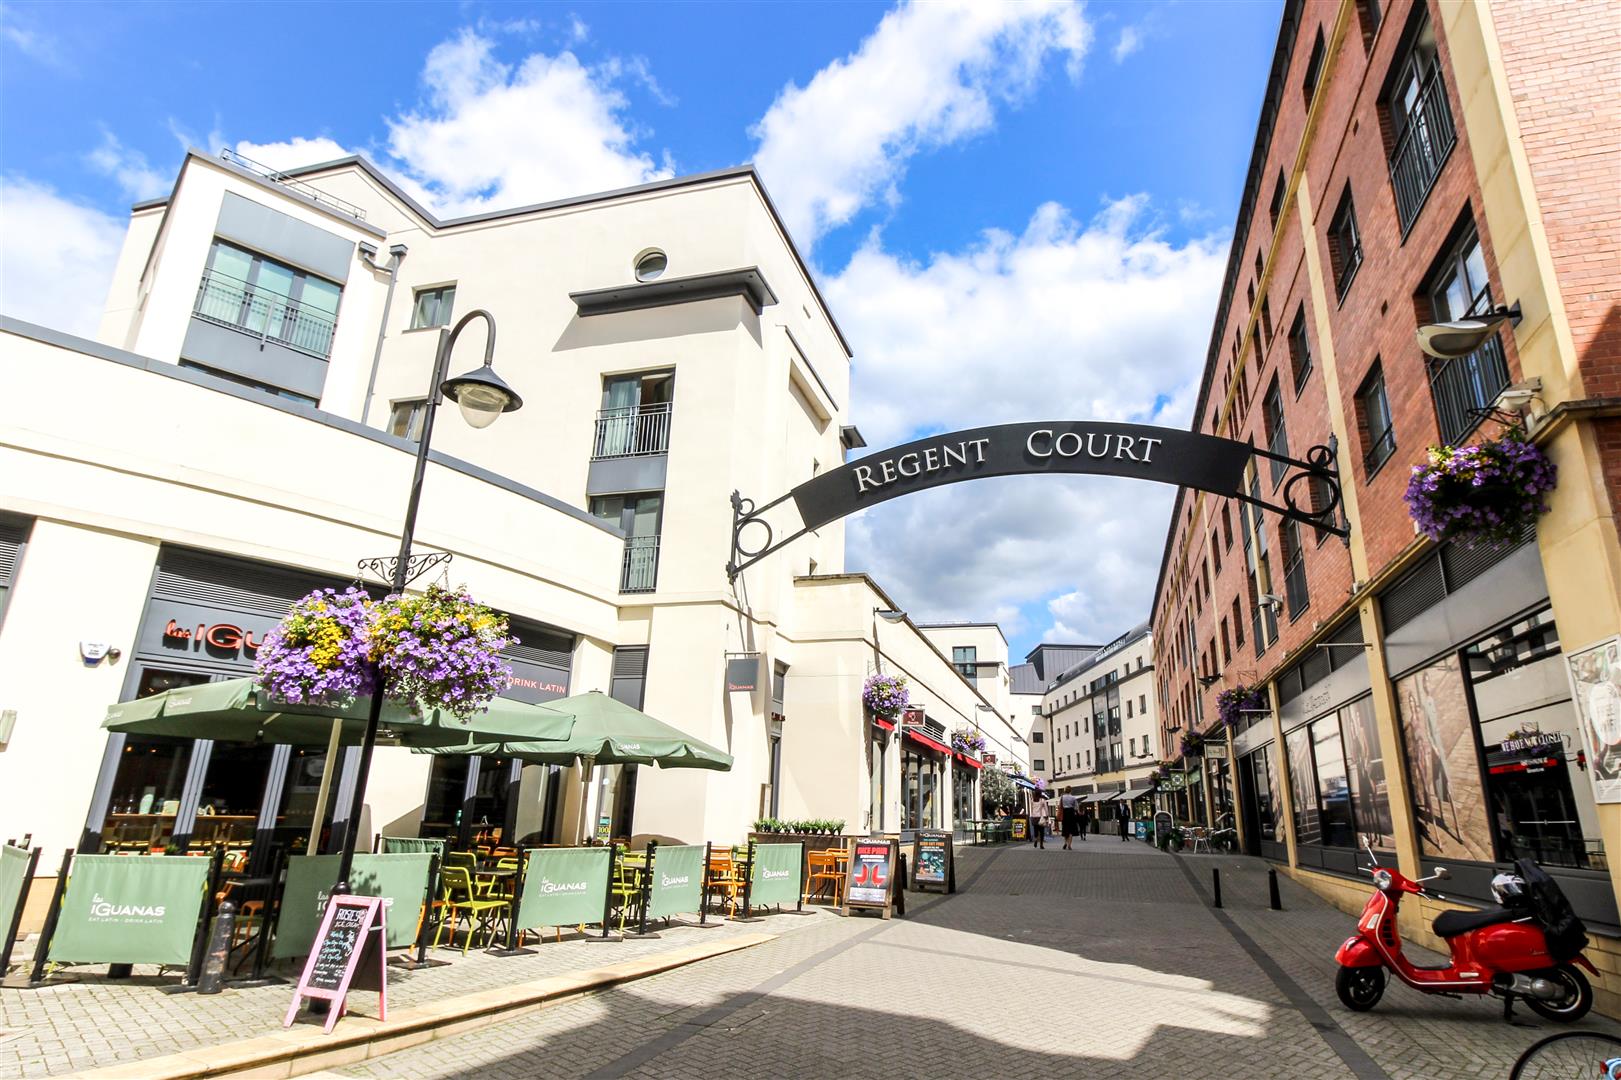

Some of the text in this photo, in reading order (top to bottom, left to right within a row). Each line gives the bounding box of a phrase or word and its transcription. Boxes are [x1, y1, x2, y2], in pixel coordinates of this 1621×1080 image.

[853, 429, 1162, 493] REGENT COURT
[194, 623, 268, 650] IGU
[508, 676, 566, 694] DRINK LATIN
[540, 882, 587, 893] IGUANAS
[91, 902, 166, 917] IGUANAS
